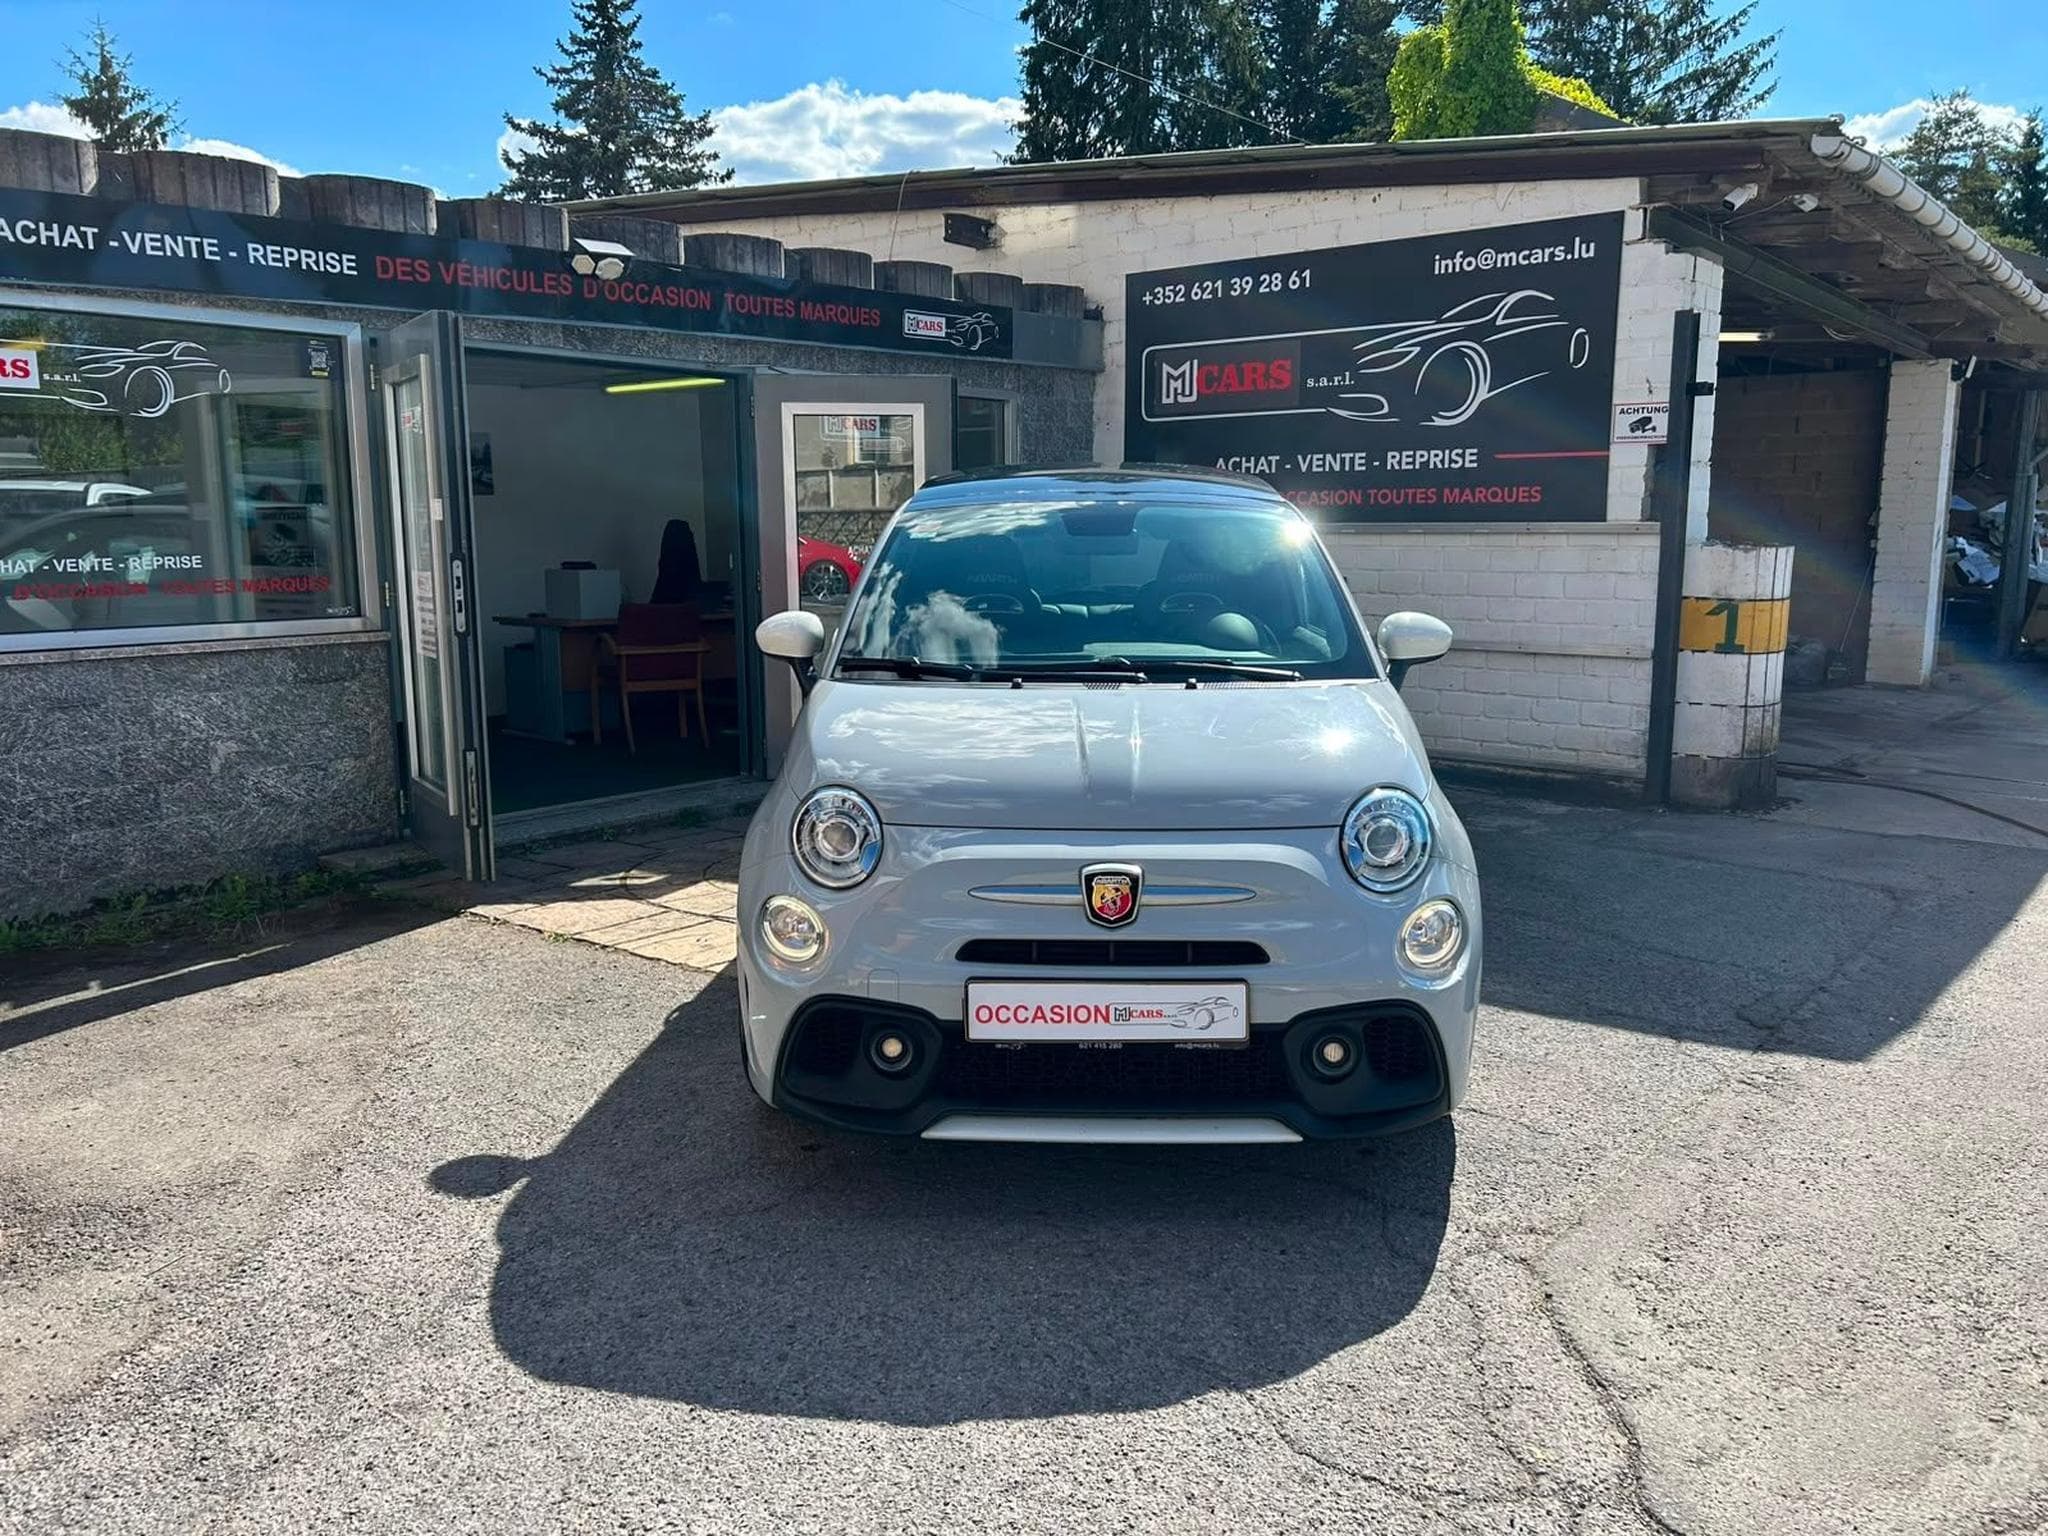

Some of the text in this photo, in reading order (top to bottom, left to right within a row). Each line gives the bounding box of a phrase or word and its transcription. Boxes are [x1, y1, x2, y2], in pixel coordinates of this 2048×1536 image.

[1434, 237, 1595, 275] info@mcars.lu
[0, 217, 98, 250] ACHAT
[248, 243, 358, 276] REPRISE
[375, 255, 431, 283] DES
[438, 257, 572, 296] VÉHICULES
[583, 279, 711, 311] D'OCCASION
[724, 292, 795, 318] TOUTES
[801, 303, 880, 327] MARQUES
[1142, 269, 1311, 305] +352 621 39 28 61
[43, 373, 81, 383] s.a.r.l.
[1306, 372, 1354, 387] s.a.r.l.
[1619, 406, 1668, 415] ACHTUNG
[1216, 456, 1280, 474] ACHAT
[1298, 453, 1366, 472] VENTE
[1387, 448, 1478, 470] REPRISE
[1284, 486, 1541, 506] CCASION TOUTES MARQUES
[53, 557, 113, 573] VENTE
[130, 555, 203, 570] REPRISE
[242, 576, 331, 593] MARQUES
[1705, 601, 1745, 653] 1
[975, 1004, 1110, 1024] OCCASION
